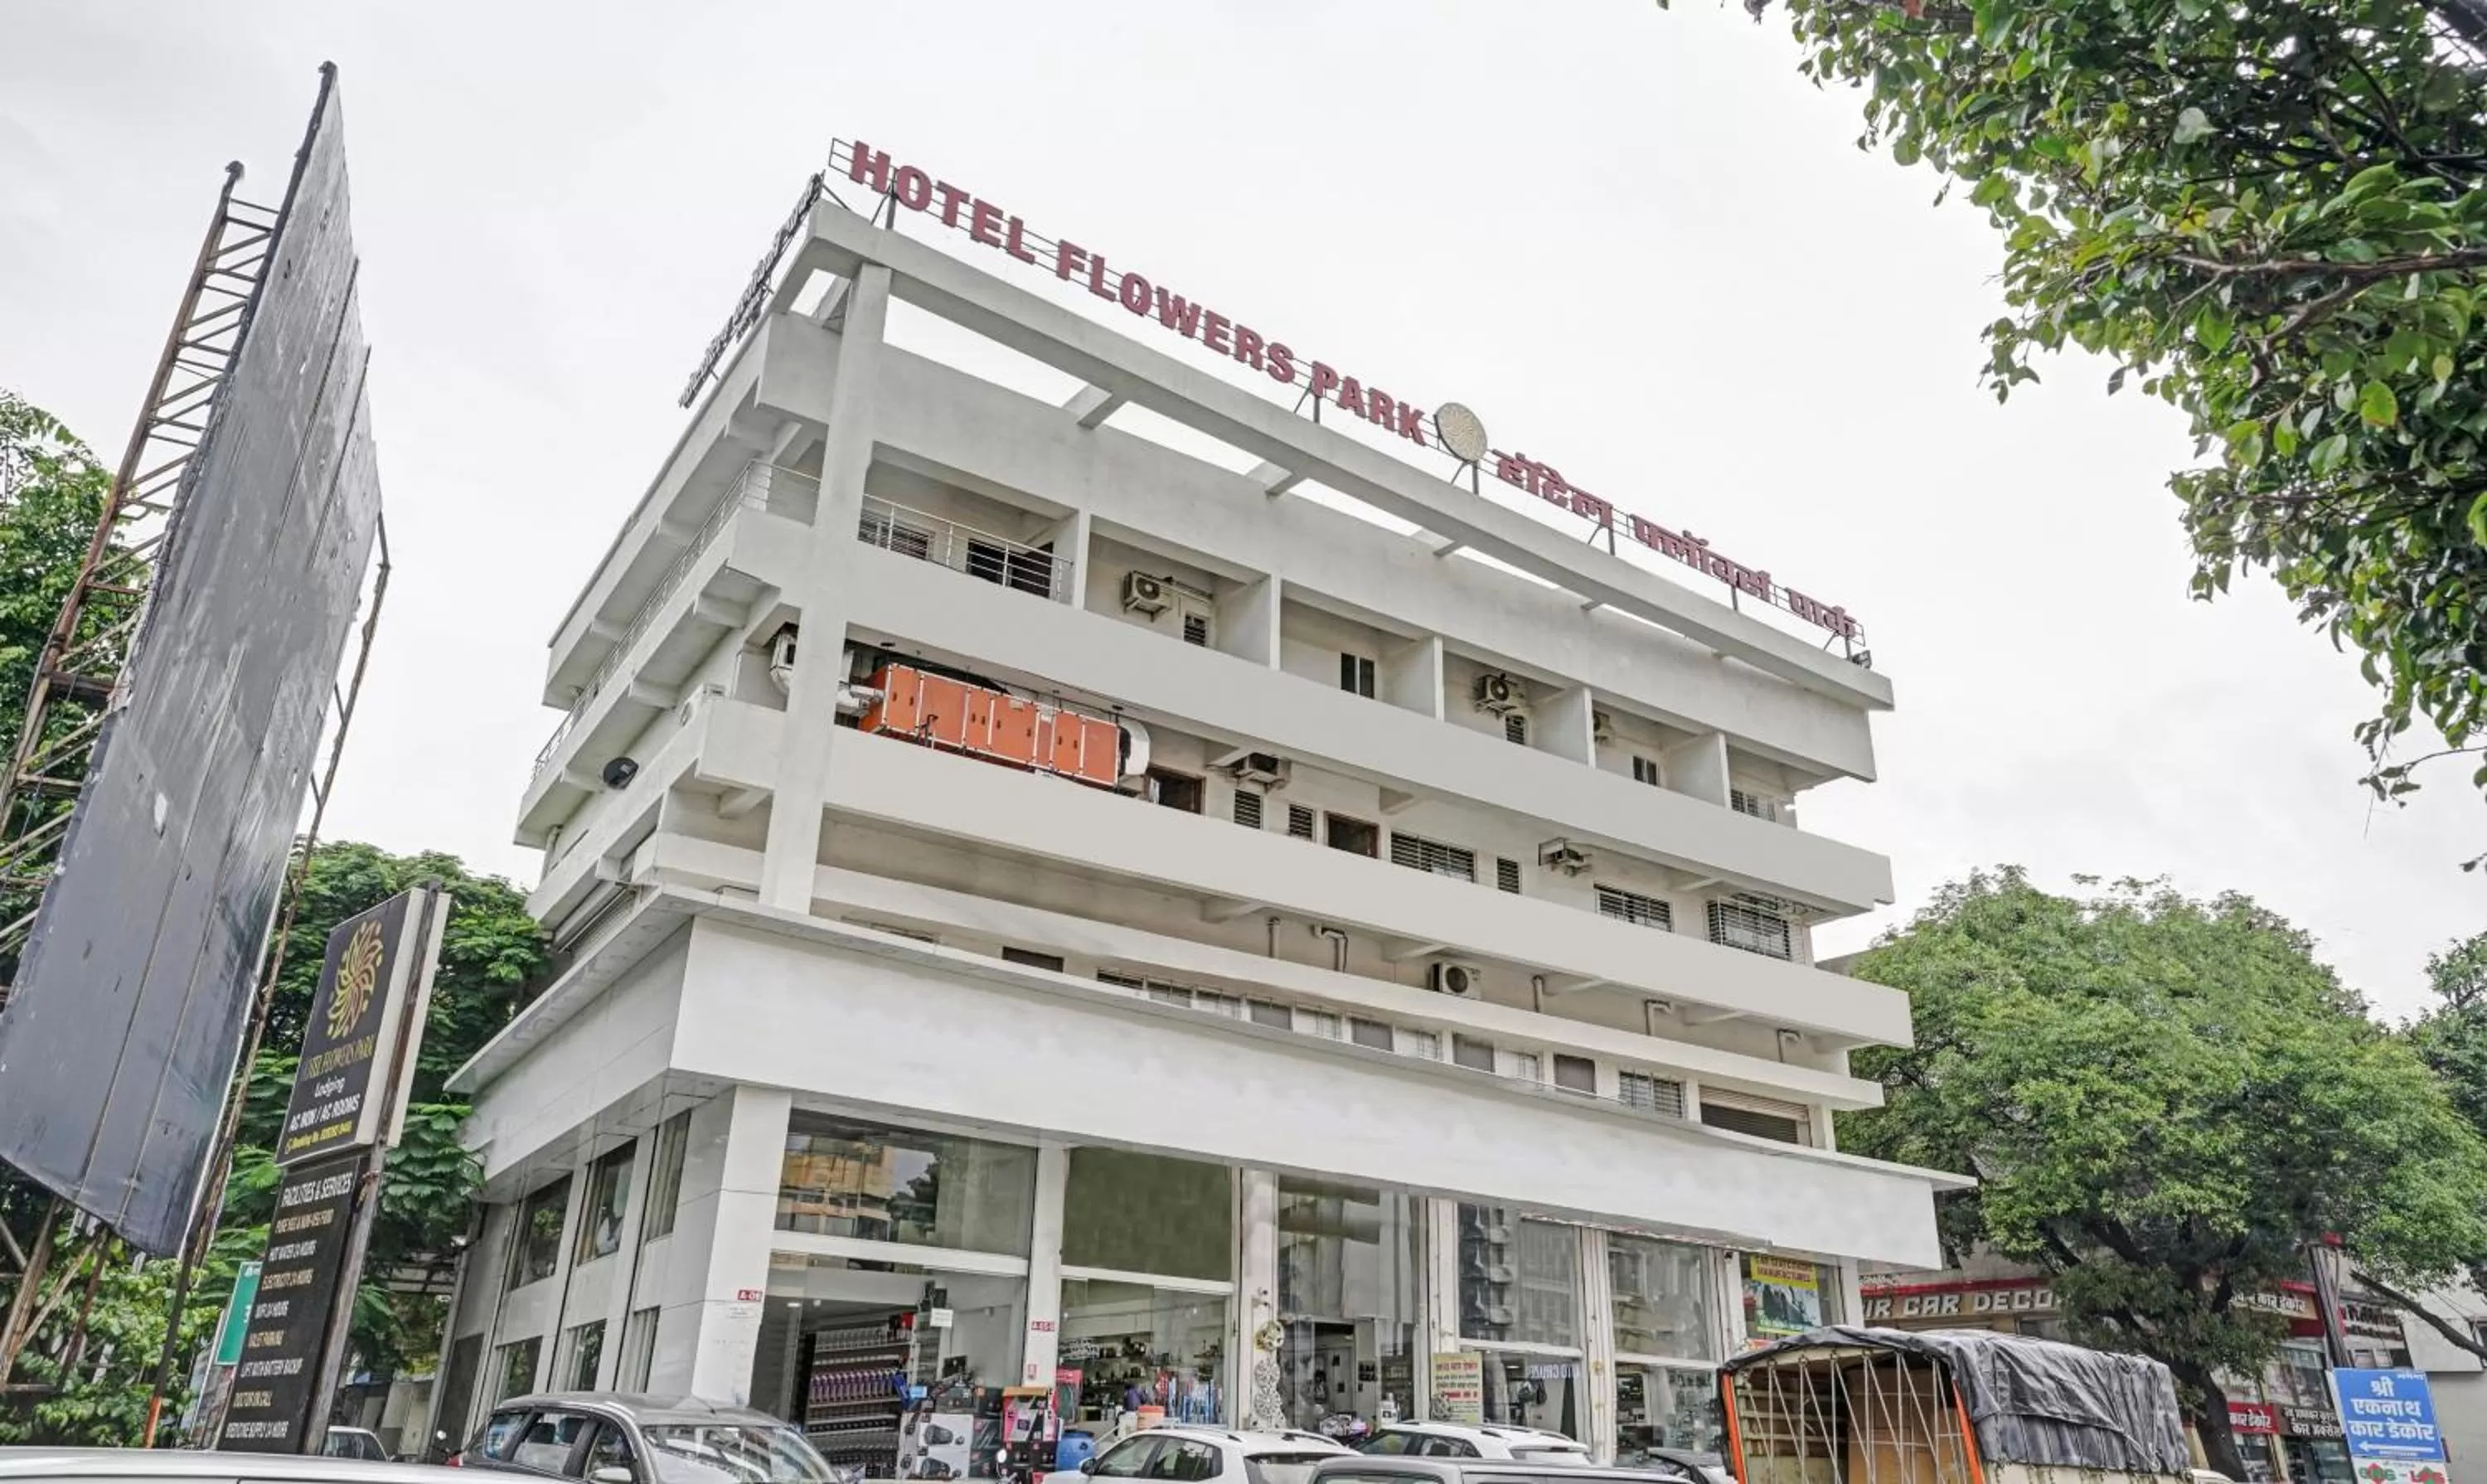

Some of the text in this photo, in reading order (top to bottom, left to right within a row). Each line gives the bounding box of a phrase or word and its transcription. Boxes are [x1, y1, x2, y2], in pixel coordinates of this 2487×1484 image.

[848, 140, 1426, 448] HOTEL FLOWERS PARK
[1785, 586, 1857, 639] पार्क
[314, 1075, 345, 1098] Lodging
[332, 1093, 361, 1118] ROOMS
[1862, 1289, 2059, 1319] IR CAR DECO
[2370, 1375, 2395, 1398] श्री
[2350, 1398, 2422, 1417] एकनाथ
[2347, 1417, 2436, 1441] कार डेकोर
